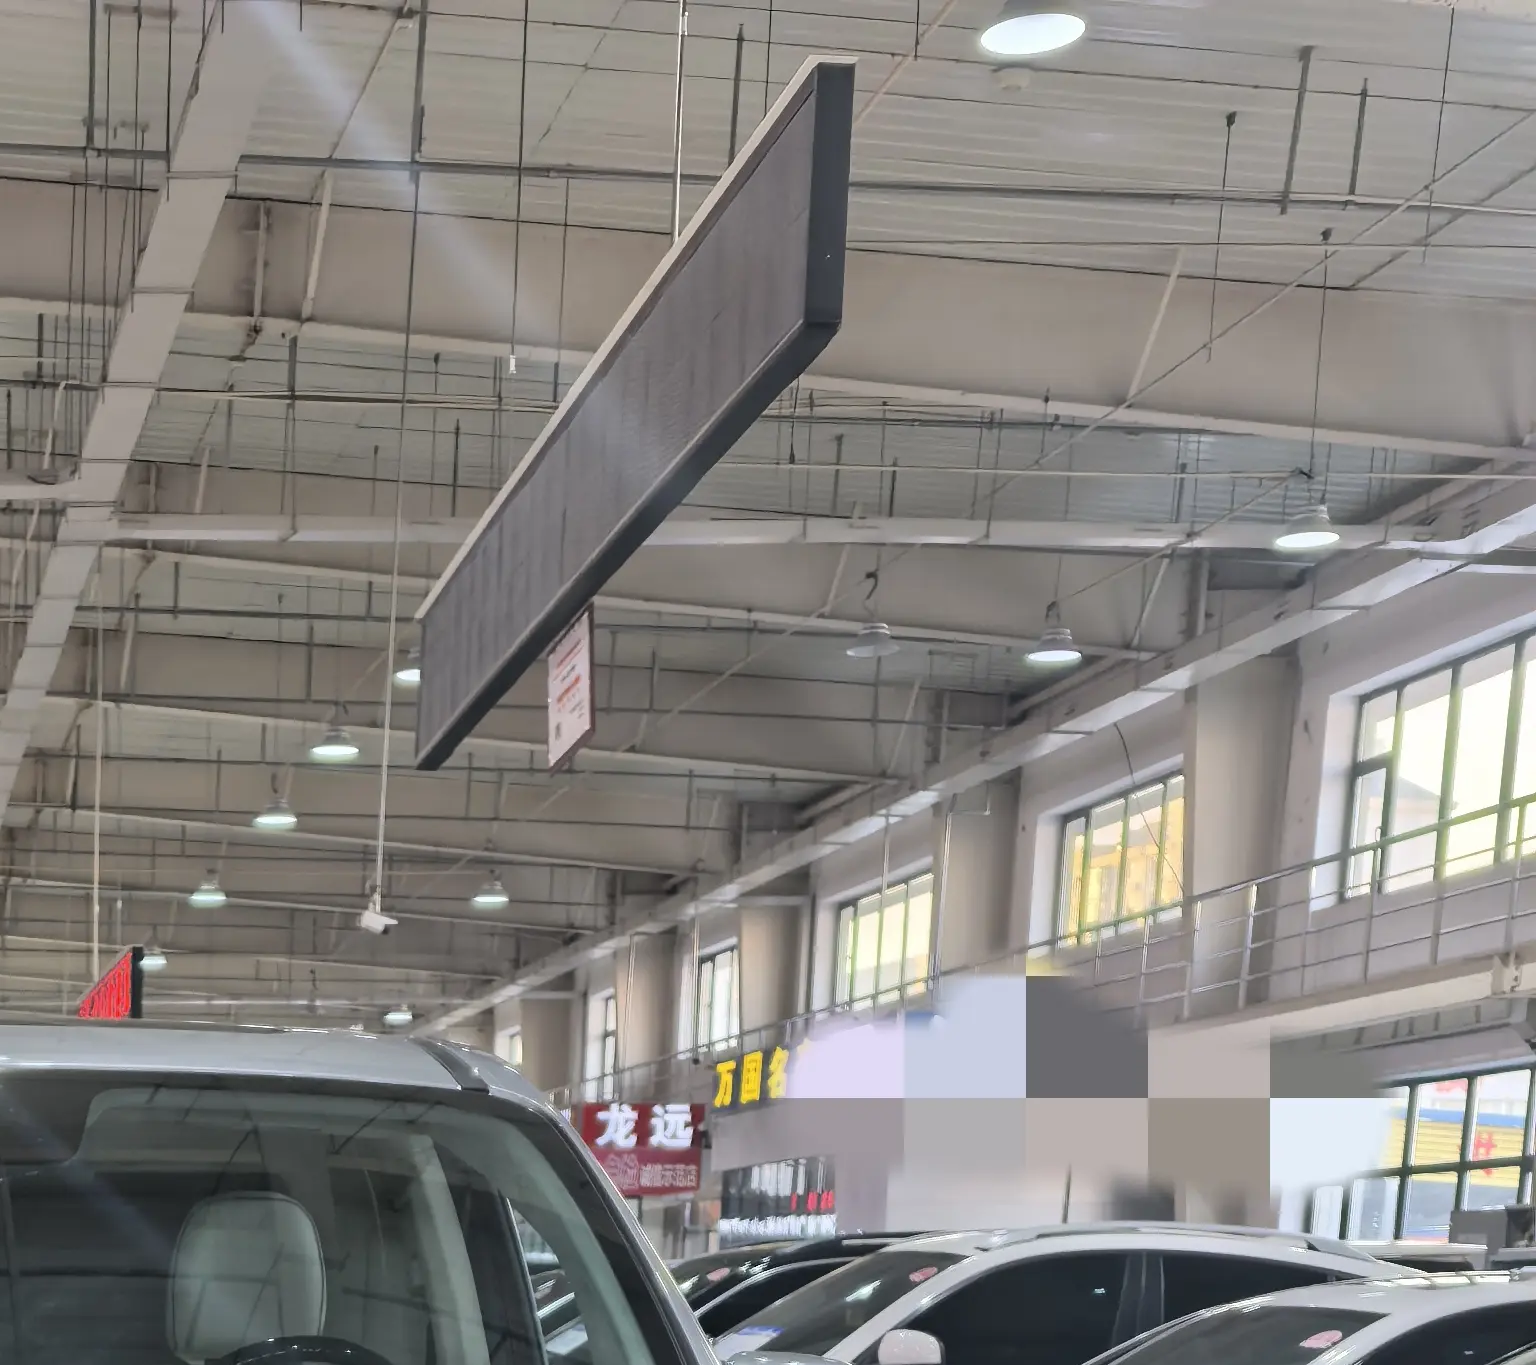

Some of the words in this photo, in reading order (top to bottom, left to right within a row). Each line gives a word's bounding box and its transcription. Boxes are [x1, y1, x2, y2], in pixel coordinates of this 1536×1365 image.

[714, 1038, 812, 1108] 万国名
[595, 1103, 693, 1147] 龙远
